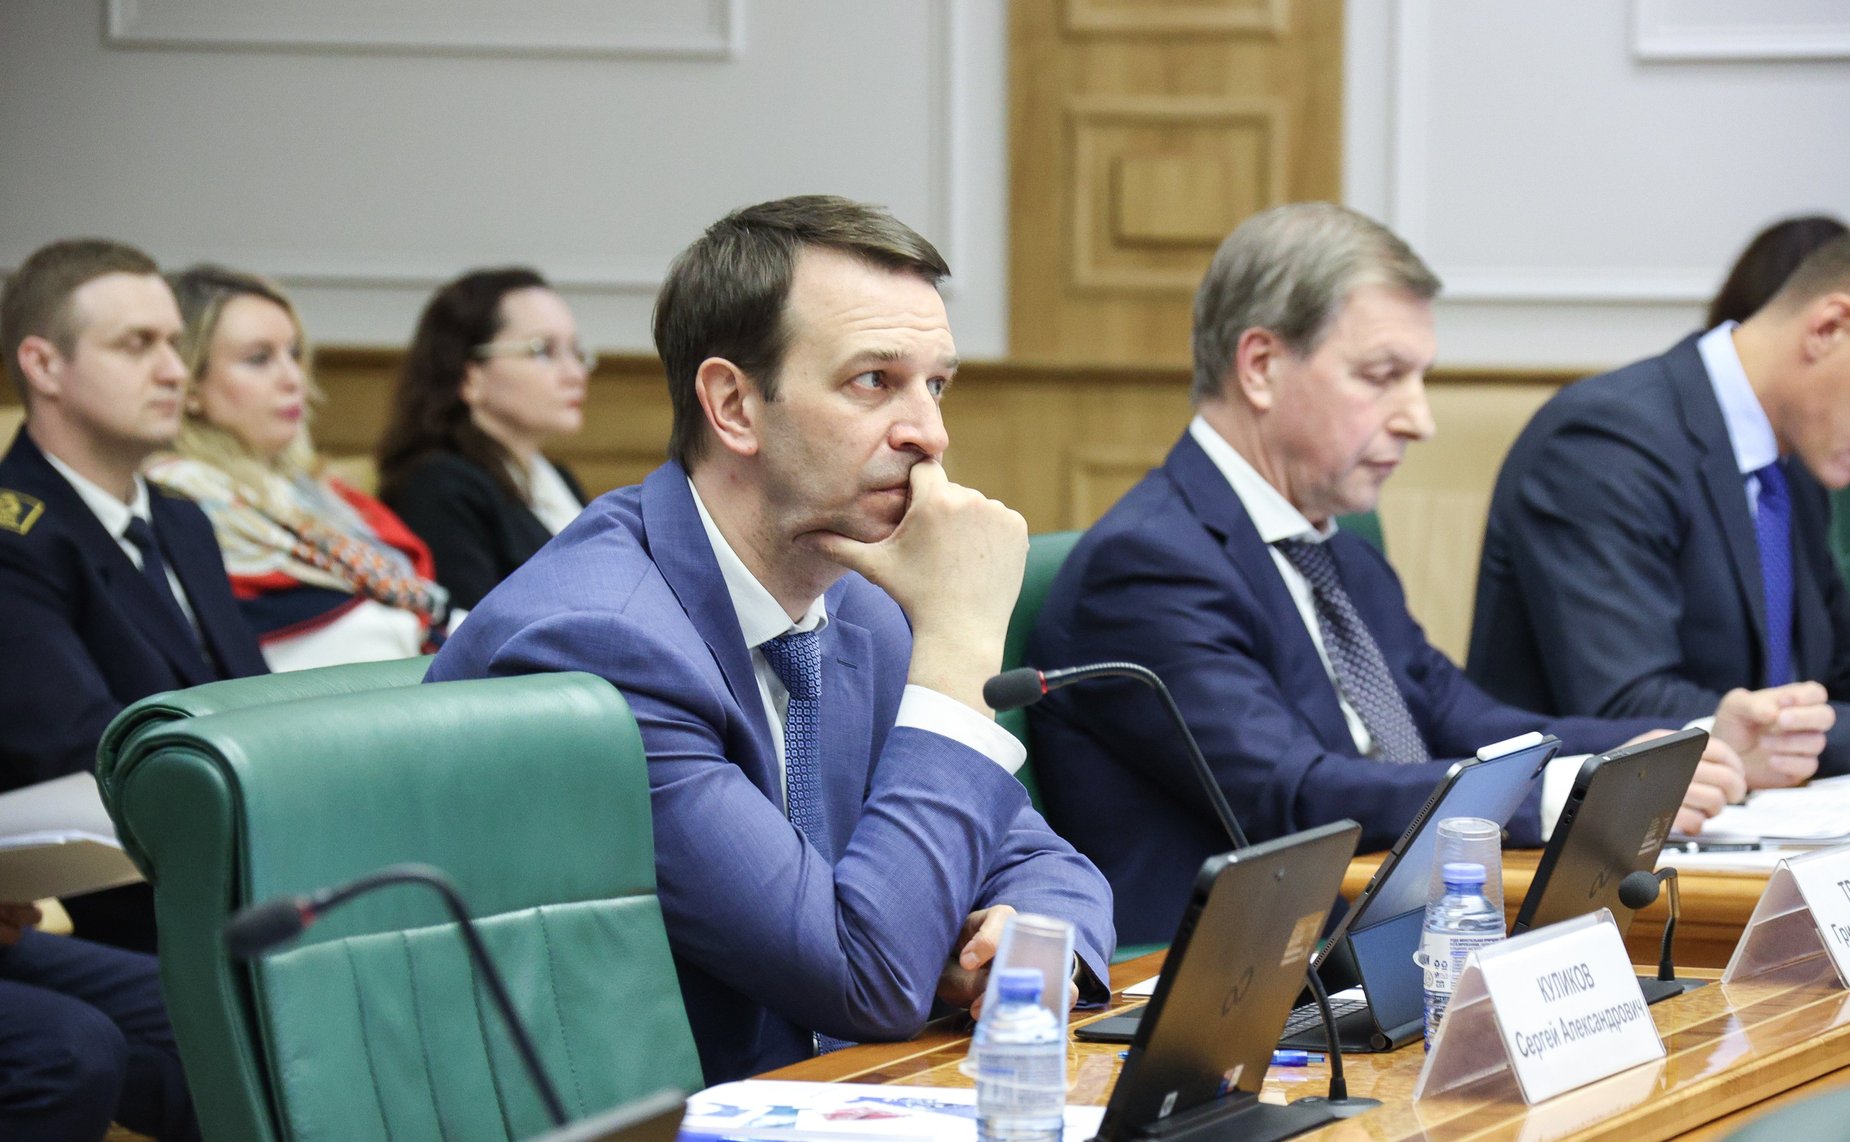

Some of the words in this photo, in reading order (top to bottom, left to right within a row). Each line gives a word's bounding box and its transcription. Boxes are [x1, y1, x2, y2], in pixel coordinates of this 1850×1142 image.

[1536, 963, 1595, 1003] КУЛИКОВ
[1515, 1020, 1562, 1060] Сергей
[1559, 998, 1646, 1044] Александрович
